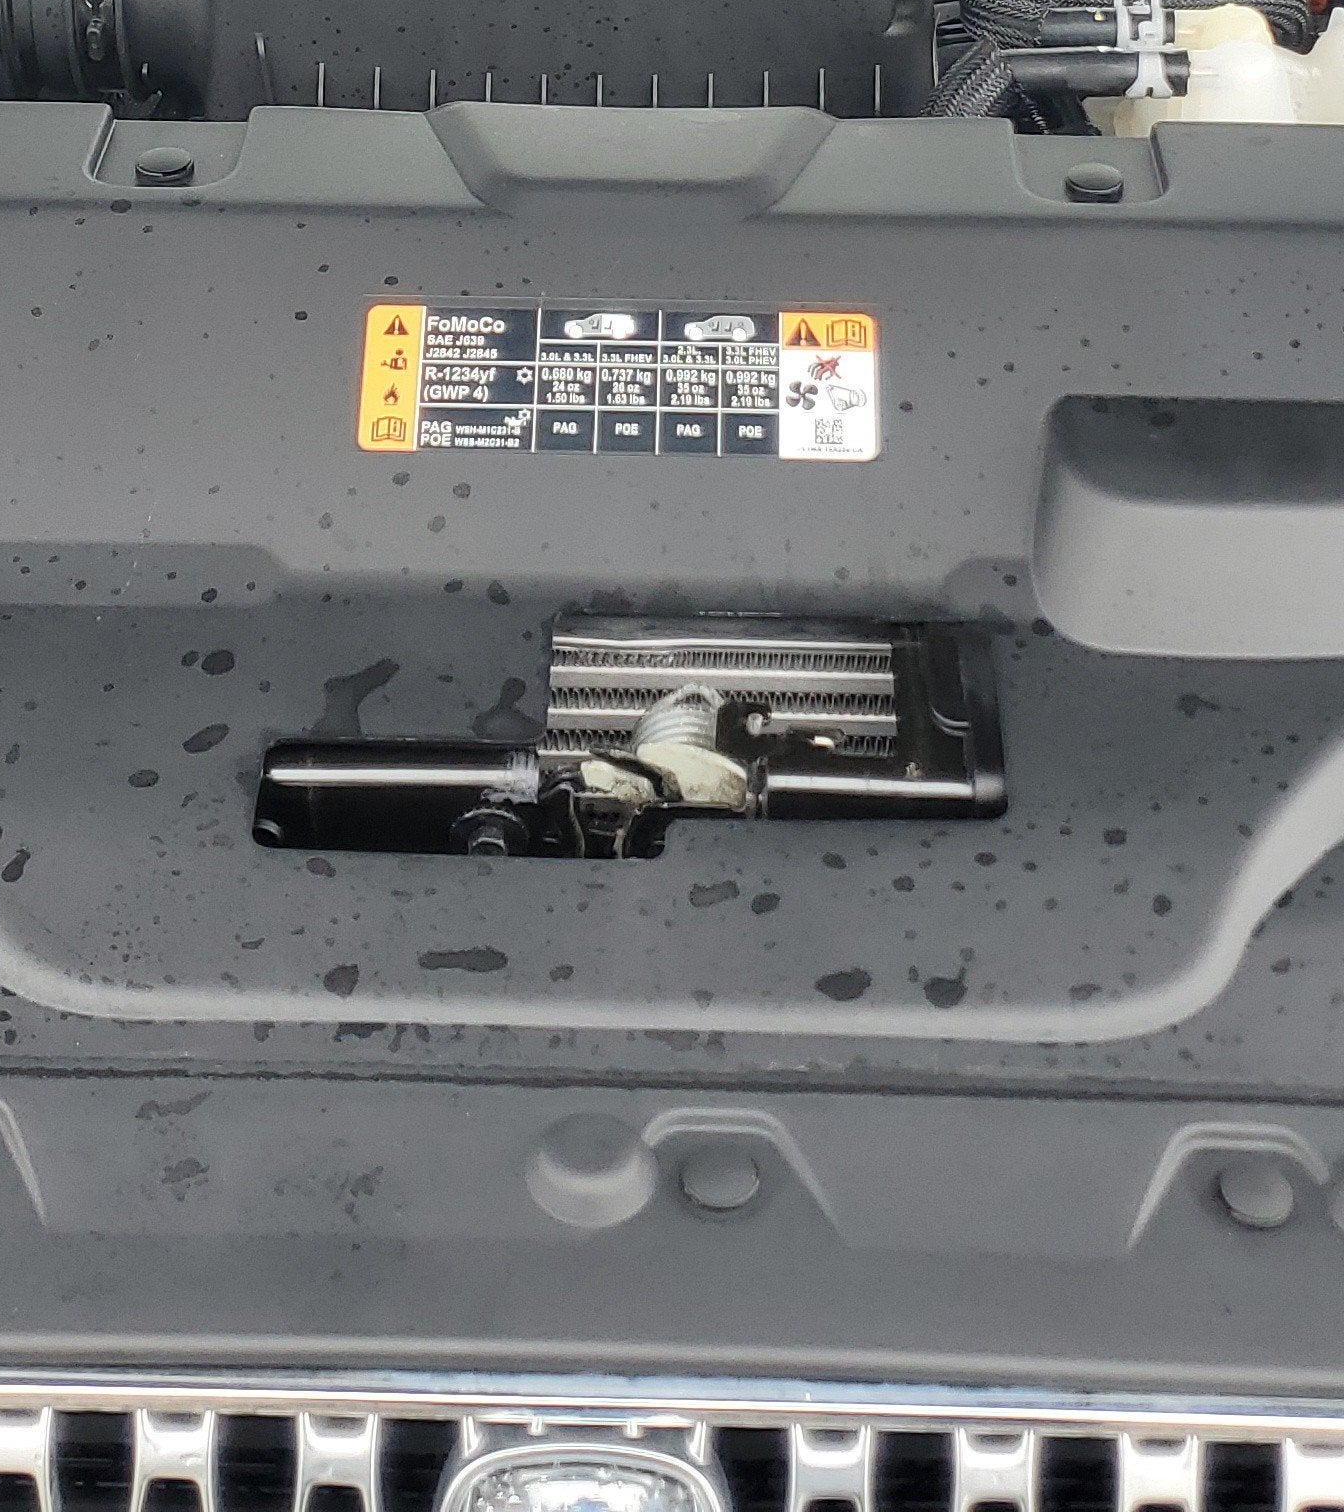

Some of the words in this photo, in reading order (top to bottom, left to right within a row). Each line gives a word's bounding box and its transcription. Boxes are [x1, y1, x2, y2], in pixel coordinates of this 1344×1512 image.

[427, 316, 506, 333] FoMoCo
[427, 335, 454, 345] SAE
[456, 335, 485, 346] J639
[425, 348, 461, 359] J2842
[540, 352, 562, 361] 3.0L
[563, 352, 572, 362] &
[573, 353, 595, 362] 3.3L
[725, 347, 747, 356] 3.3L
[748, 347, 777, 356] FHEV
[601, 353, 623, 363] 3.3L
[624, 354, 653, 363] FHEV
[725, 355, 747, 365] 3.0L
[748, 356, 777, 365] PHEV
[424, 366, 497, 385] R-1234yf
[541, 367, 574, 381] 0.680
[576, 368, 592, 384] kg
[601, 368, 634, 382] 0.737
[636, 369, 652, 385] kg
[665, 369, 698, 383] 0.992
[700, 369, 716, 386] kg
[725, 370, 758, 384] 0.992
[760, 371, 776, 388] kg
[552, 381, 565, 392] 24
[567, 383, 580, 393] oz
[626, 384, 641, 394] oz
[677, 382, 690, 394] 35
[691, 384, 705, 394] oz
[737, 384, 750, 396] 35
[751, 386, 765, 396] oz
[423, 385, 471, 402] (GWP
[472, 385, 489, 403] 4)
[546, 392, 568, 403] 1.50
[569, 393, 586, 404] lbs
[629, 394, 646, 405] lbs
[694, 395, 711, 406] lbs
[754, 396, 771, 408] lbs
[421, 420, 453, 433] PAG
[552, 421, 578, 435] PAG
[614, 422, 640, 436] POE
[676, 423, 702, 437] PAG
[738, 425, 764, 439] POE
[420, 433, 452, 446] POE
